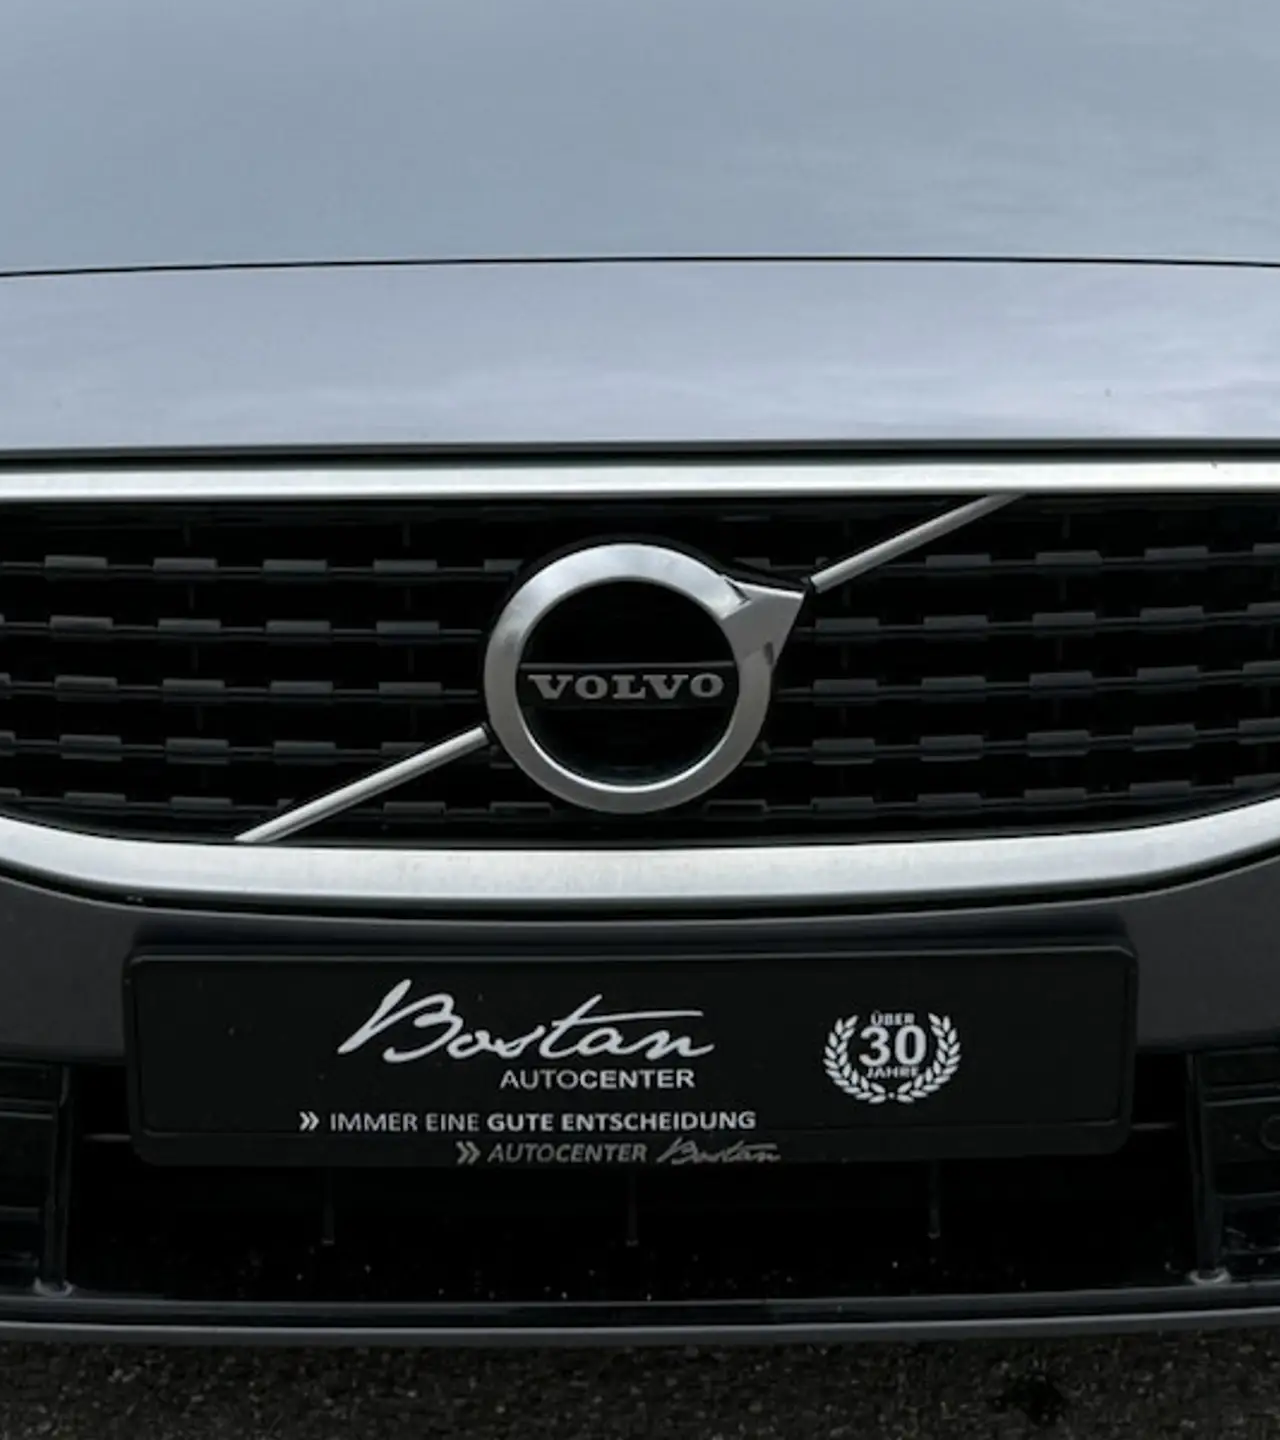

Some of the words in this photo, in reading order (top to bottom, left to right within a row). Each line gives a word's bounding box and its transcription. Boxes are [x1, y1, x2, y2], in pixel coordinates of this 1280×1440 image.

[527, 672, 725, 700] VOLVO
[336, 978, 716, 1062] Bostan
[870, 1010, 916, 1026] ÜBER
[858, 1024, 928, 1068] 30
[499, 1068, 696, 1090] AUTOCENTER
[866, 1065, 920, 1079] JAHRE
[329, 1112, 419, 1132] IMMER
[425, 1112, 480, 1132] EINE
[486, 1112, 554, 1132] GUTE
[560, 1111, 757, 1132] ENTSCHEIDUNG
[486, 1142, 647, 1163] AUTOCENTER
[655, 1136, 781, 1165] Bostan
